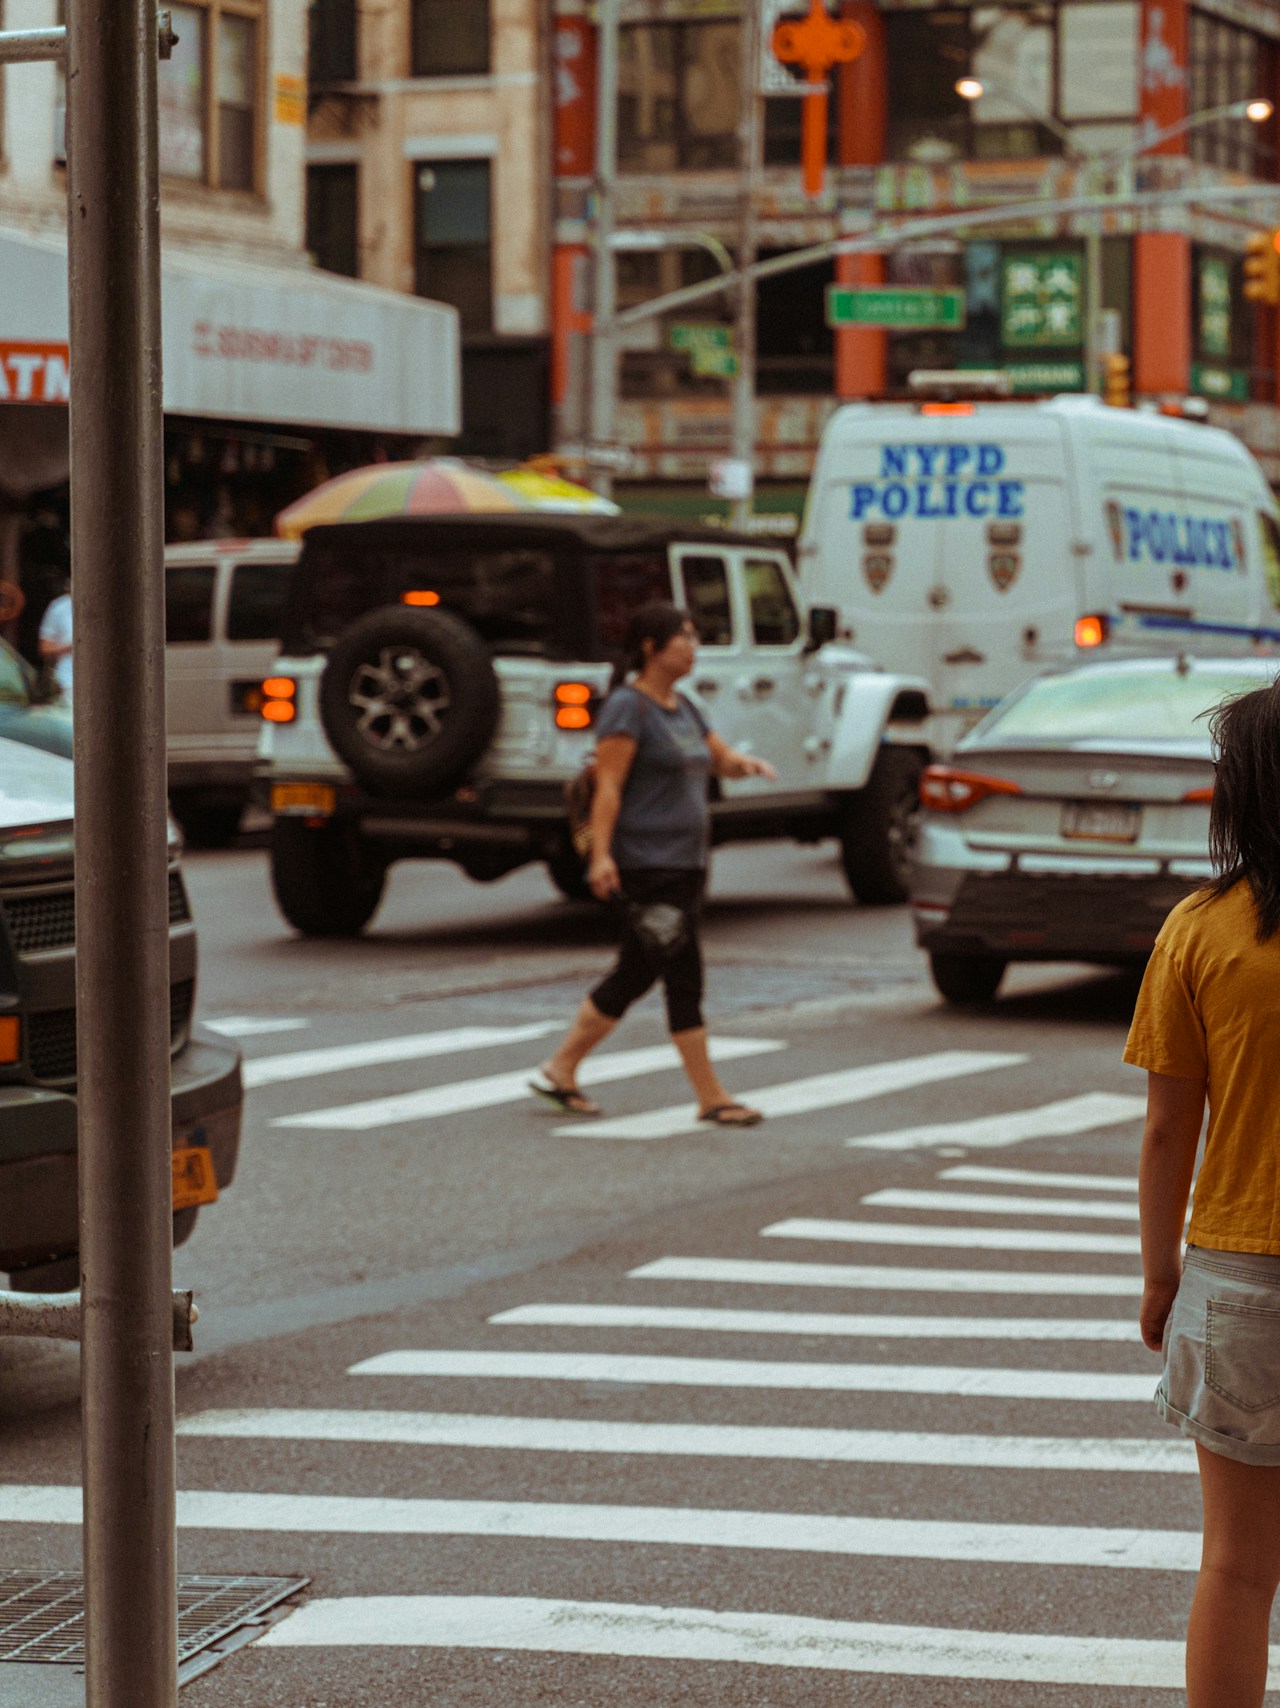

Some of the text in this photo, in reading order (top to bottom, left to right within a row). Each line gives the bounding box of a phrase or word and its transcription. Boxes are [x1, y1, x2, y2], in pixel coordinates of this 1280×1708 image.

[0, 353, 69, 401] TM
[879, 443, 1005, 477] NYPD
[850, 481, 1025, 519] POLICE
[1123, 506, 1235, 571] POLICE
